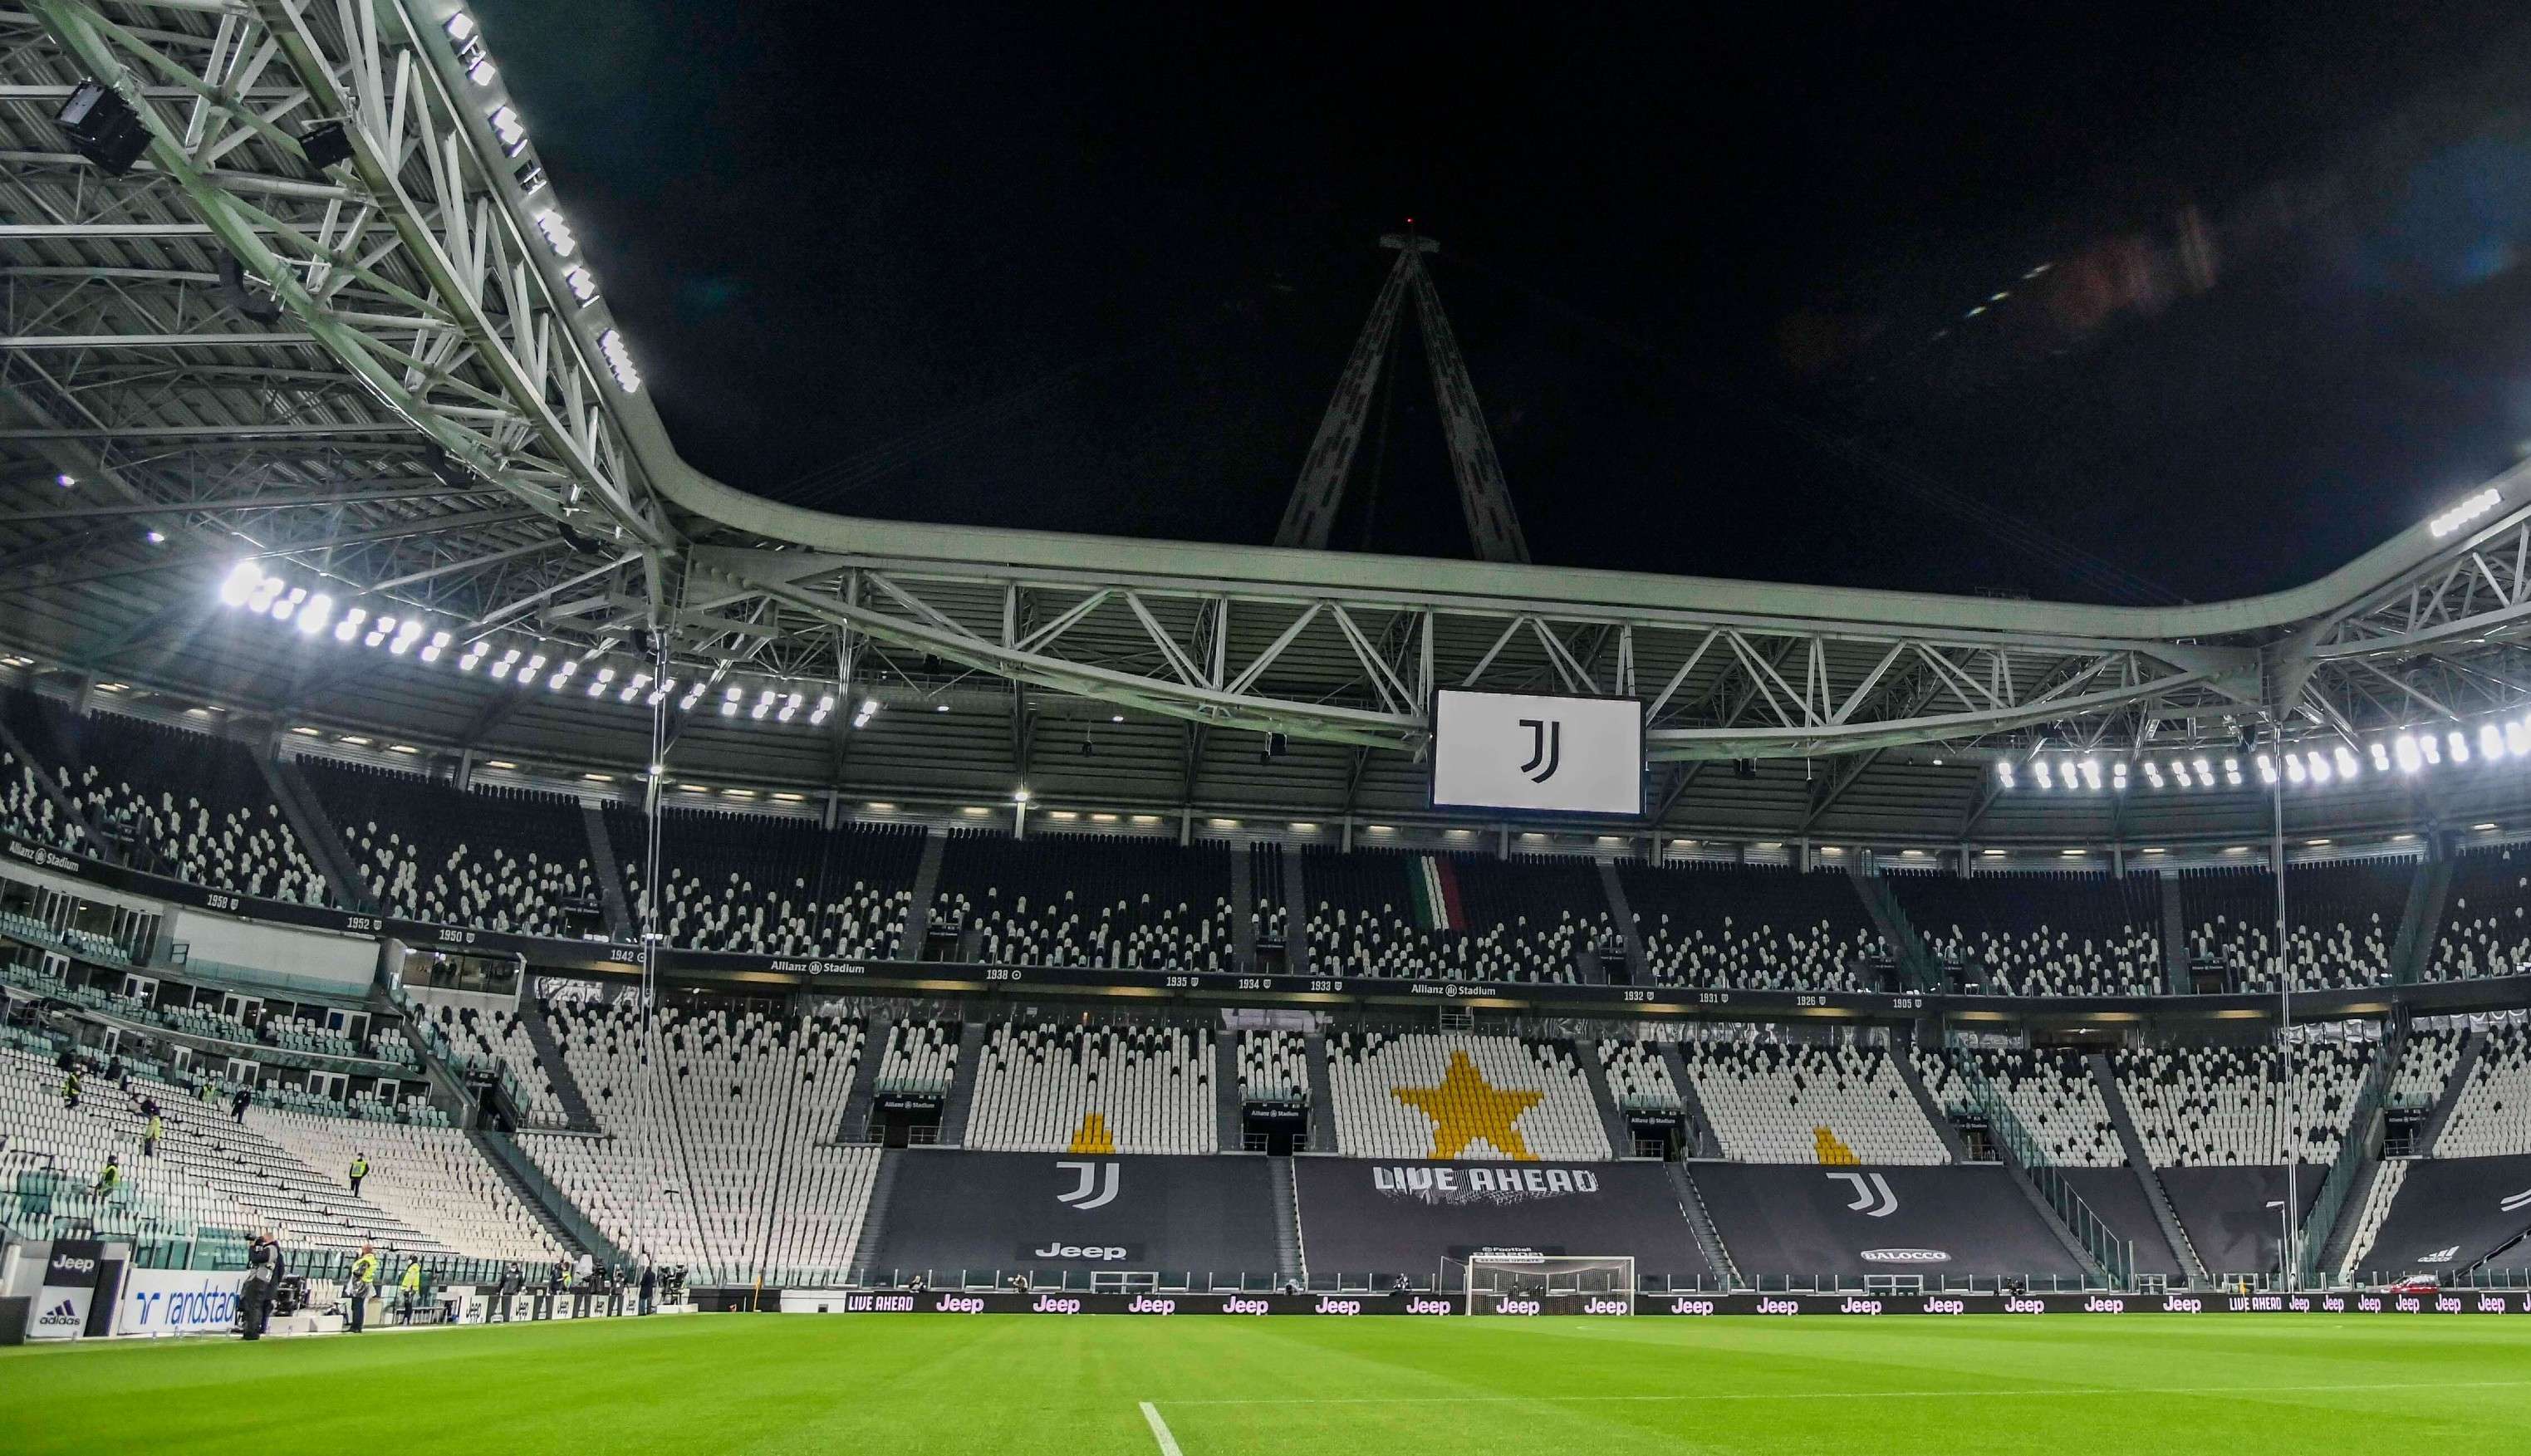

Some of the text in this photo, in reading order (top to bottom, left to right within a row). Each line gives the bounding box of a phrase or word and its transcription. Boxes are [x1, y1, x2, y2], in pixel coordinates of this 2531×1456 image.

[9, 841, 79, 872] Allianz Stadium
[207, 894, 228, 908] 1958
[347, 916, 370, 929] 1952
[439, 929, 462, 943] 1950
[611, 949, 634, 962] 1942
[771, 960, 865, 974] Allianz Stadium
[986, 969, 1008, 980] 1938
[1166, 976, 1188, 987] 1935
[1239, 978, 1260, 989] 1934
[1411, 983, 1496, 996] Allianz Stadium
[1624, 991, 1644, 1001] 1932
[1700, 993, 1719, 1003] 1931
[1797, 996, 1816, 1006] 1926
[1372, 1166, 1601, 1194] LIVE AHEAD
[1035, 1242, 1127, 1261] Jeep
[1864, 1252, 1946, 1260] BALOCCO
[52, 1253, 95, 1272] Jeep
[848, 1296, 914, 1311] LIVE AHEAD
[936, 1294, 984, 1314] Jeep
[1033, 1294, 1081, 1314] Jeep
[1128, 1295, 1175, 1315] Jeep
[1223, 1296, 1268, 1315] Jeep
[1315, 1296, 1361, 1315] Jeep
[1406, 1297, 1451, 1315] Jeep
[1496, 1297, 1540, 1316] Jeep
[1584, 1297, 1628, 1316] Jeep
[1671, 1297, 1714, 1316] Jeep
[1757, 1297, 1798, 1316] Jeep
[1841, 1297, 1882, 1315] Jeep
[1923, 1297, 1964, 1315] Jeep
[2004, 1297, 2045, 1314] Jeep
[2084, 1296, 2124, 1314] Jeep
[2162, 1296, 2202, 1313] Jeep
[2229, 1297, 2282, 1311] LIVE AHEAD
[2288, 1295, 2310, 1313] Jeep
[2323, 1294, 2345, 1313] Jeep
[2357, 1294, 2381, 1313] Jeep
[2395, 1294, 2420, 1313] Jeep
[2435, 1294, 2461, 1314] Jeep
[2477, 1293, 2505, 1315] Jeep
[40, 1316, 81, 1326] adidas
